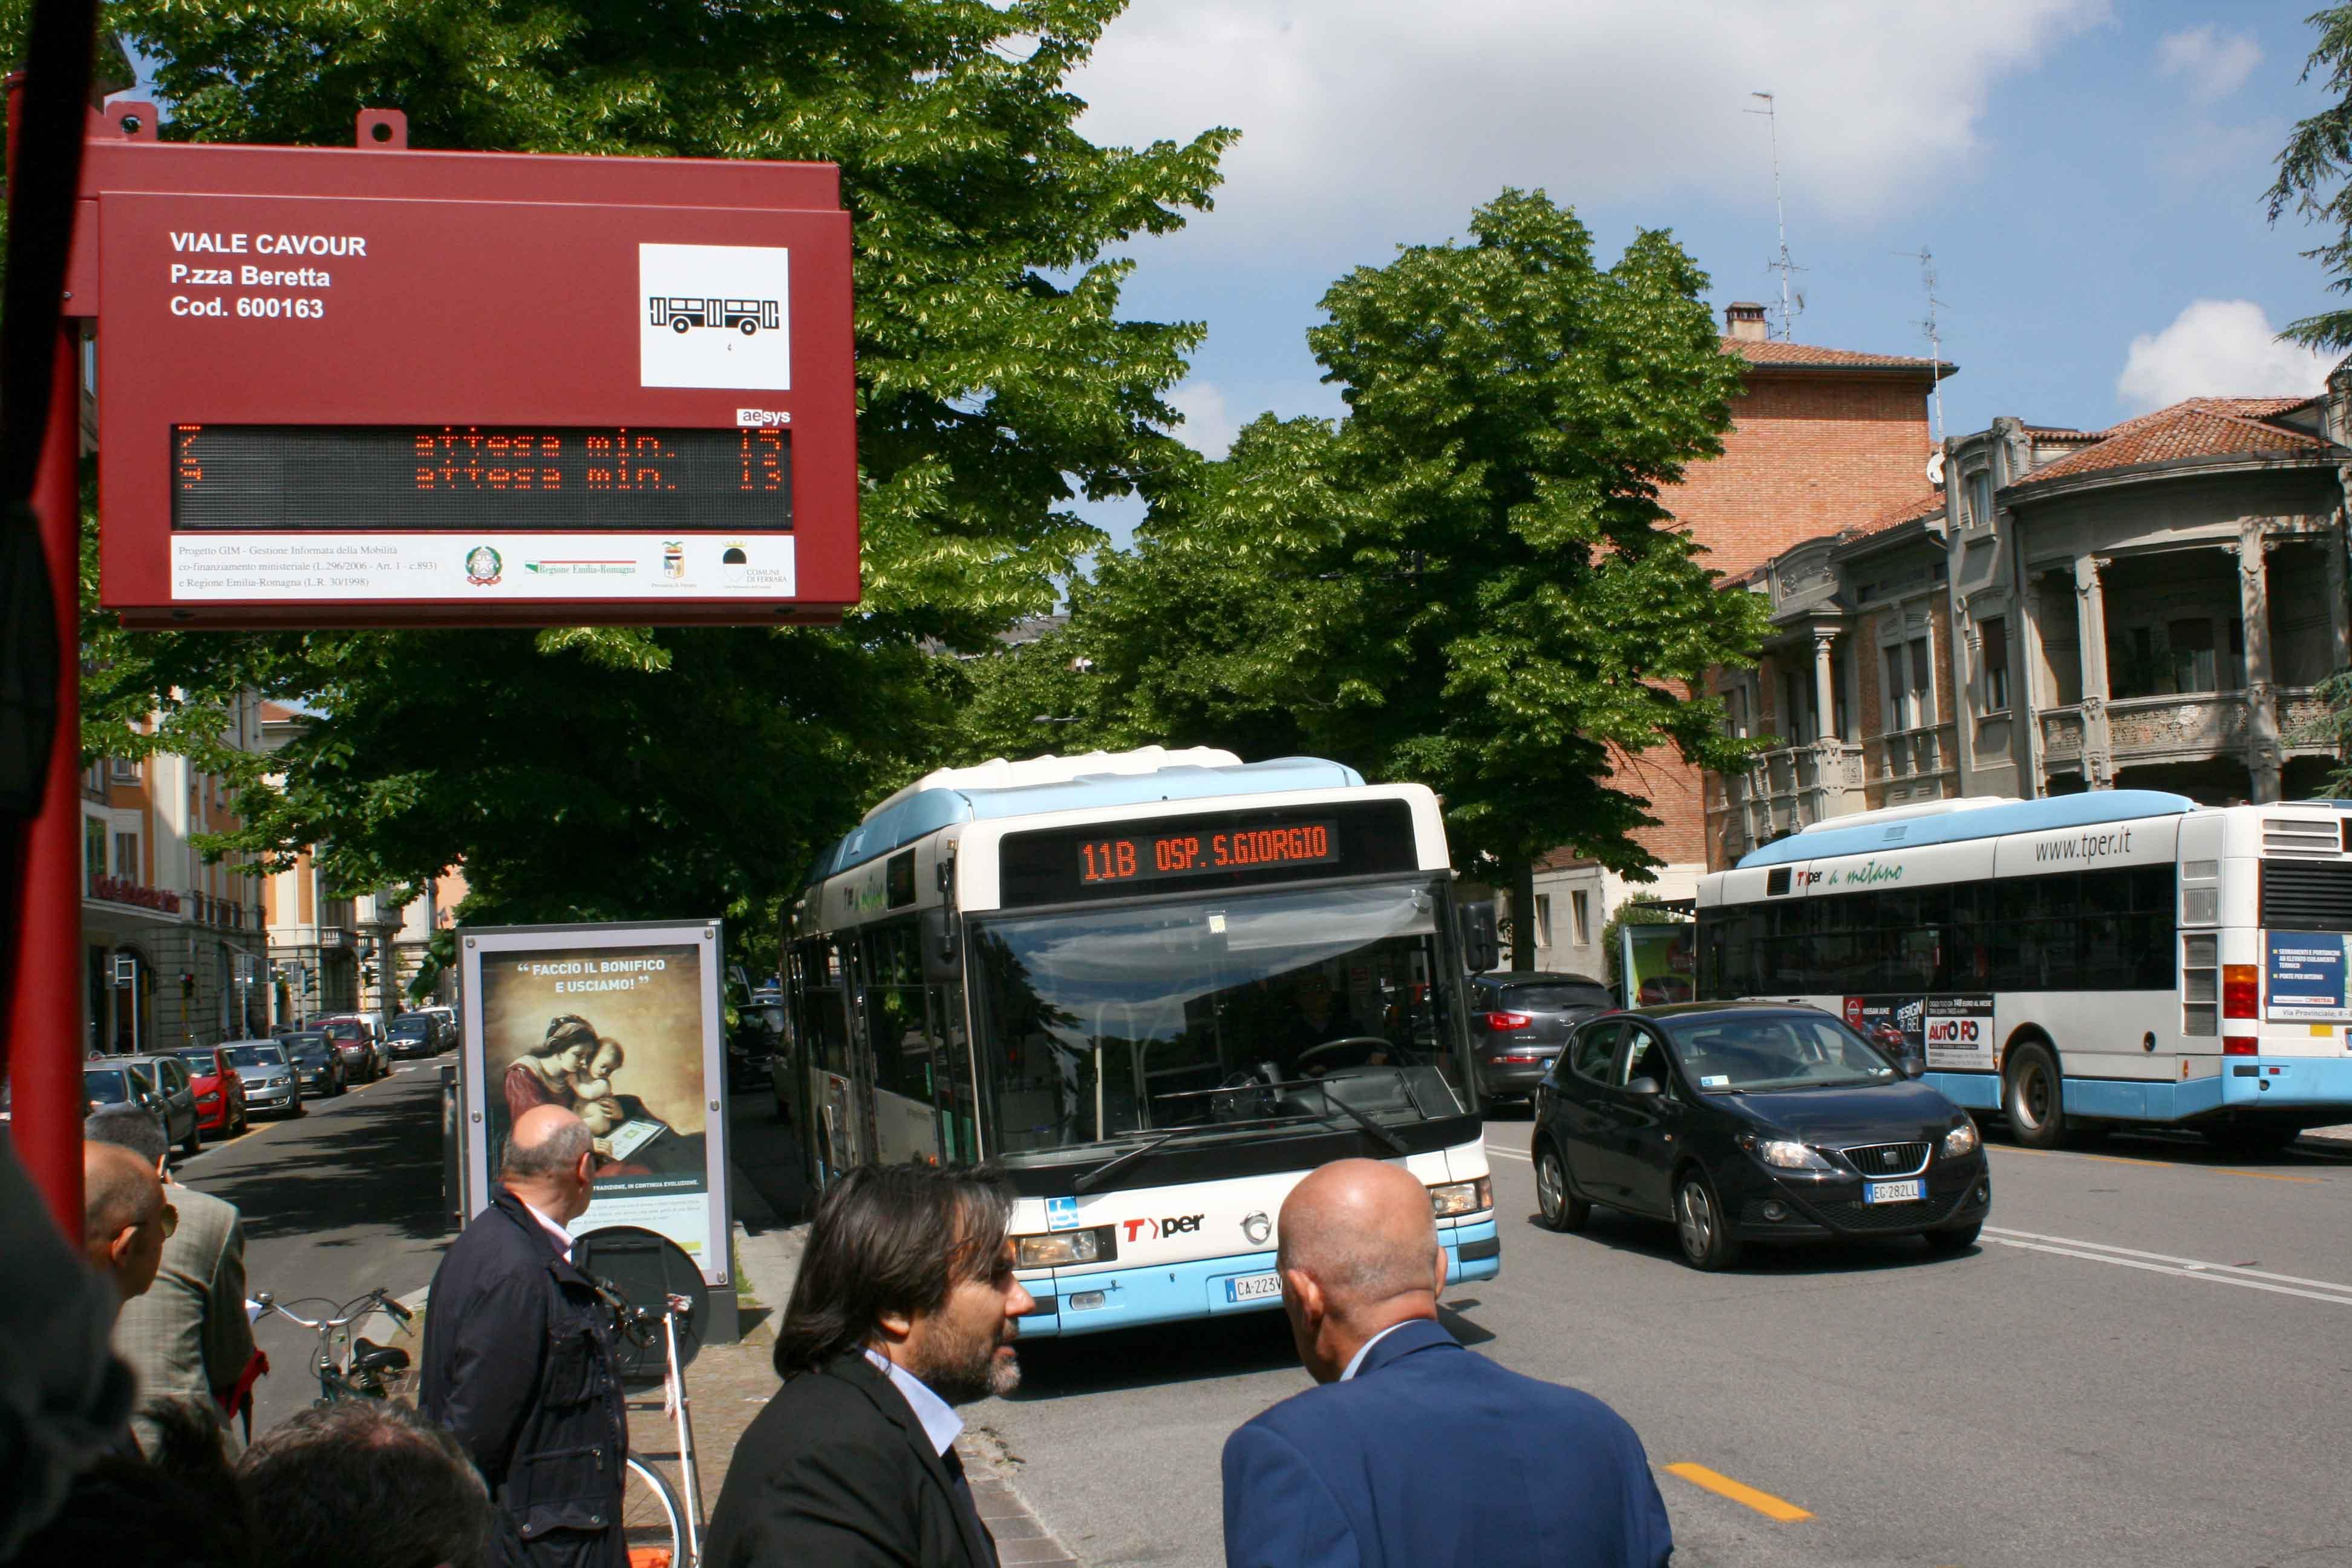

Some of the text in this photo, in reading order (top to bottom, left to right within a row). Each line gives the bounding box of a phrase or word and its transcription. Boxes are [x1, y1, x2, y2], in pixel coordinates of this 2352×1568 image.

[169, 232, 367, 256] VIALE CAVOUR
[171, 264, 330, 287] P.zza Beretta
[171, 296, 324, 318] Cod. 600163
[742, 410, 791, 426] aesys
[179, 546, 217, 557] Progetto
[219, 546, 240, 555] GIM
[249, 546, 289, 555] Gestione
[291, 546, 334, 555] Informata
[336, 546, 358, 554] della
[179, 563, 256, 571] co-finanziamento
[259, 562, 310, 570] ministeriale
[539, 564, 636, 575] Regione Emilia-Romagna
[187, 578, 224, 589] Regione
[227, 578, 301, 588] Emilia-Romagna
[329, 578, 369, 587] 30/1998)
[1083, 826, 1327, 881] 11B OSP. S.GIORGIO
[2036, 826, 2131, 865] www.tper.it
[1846, 858, 1904, 884] metano
[584, 962, 597, 973] IL
[601, 959, 665, 973] BONIFICO
[555, 982, 564, 993] E
[567, 978, 635, 993] USCIAMO!
[1897, 999, 1924, 1021] DESIGN
